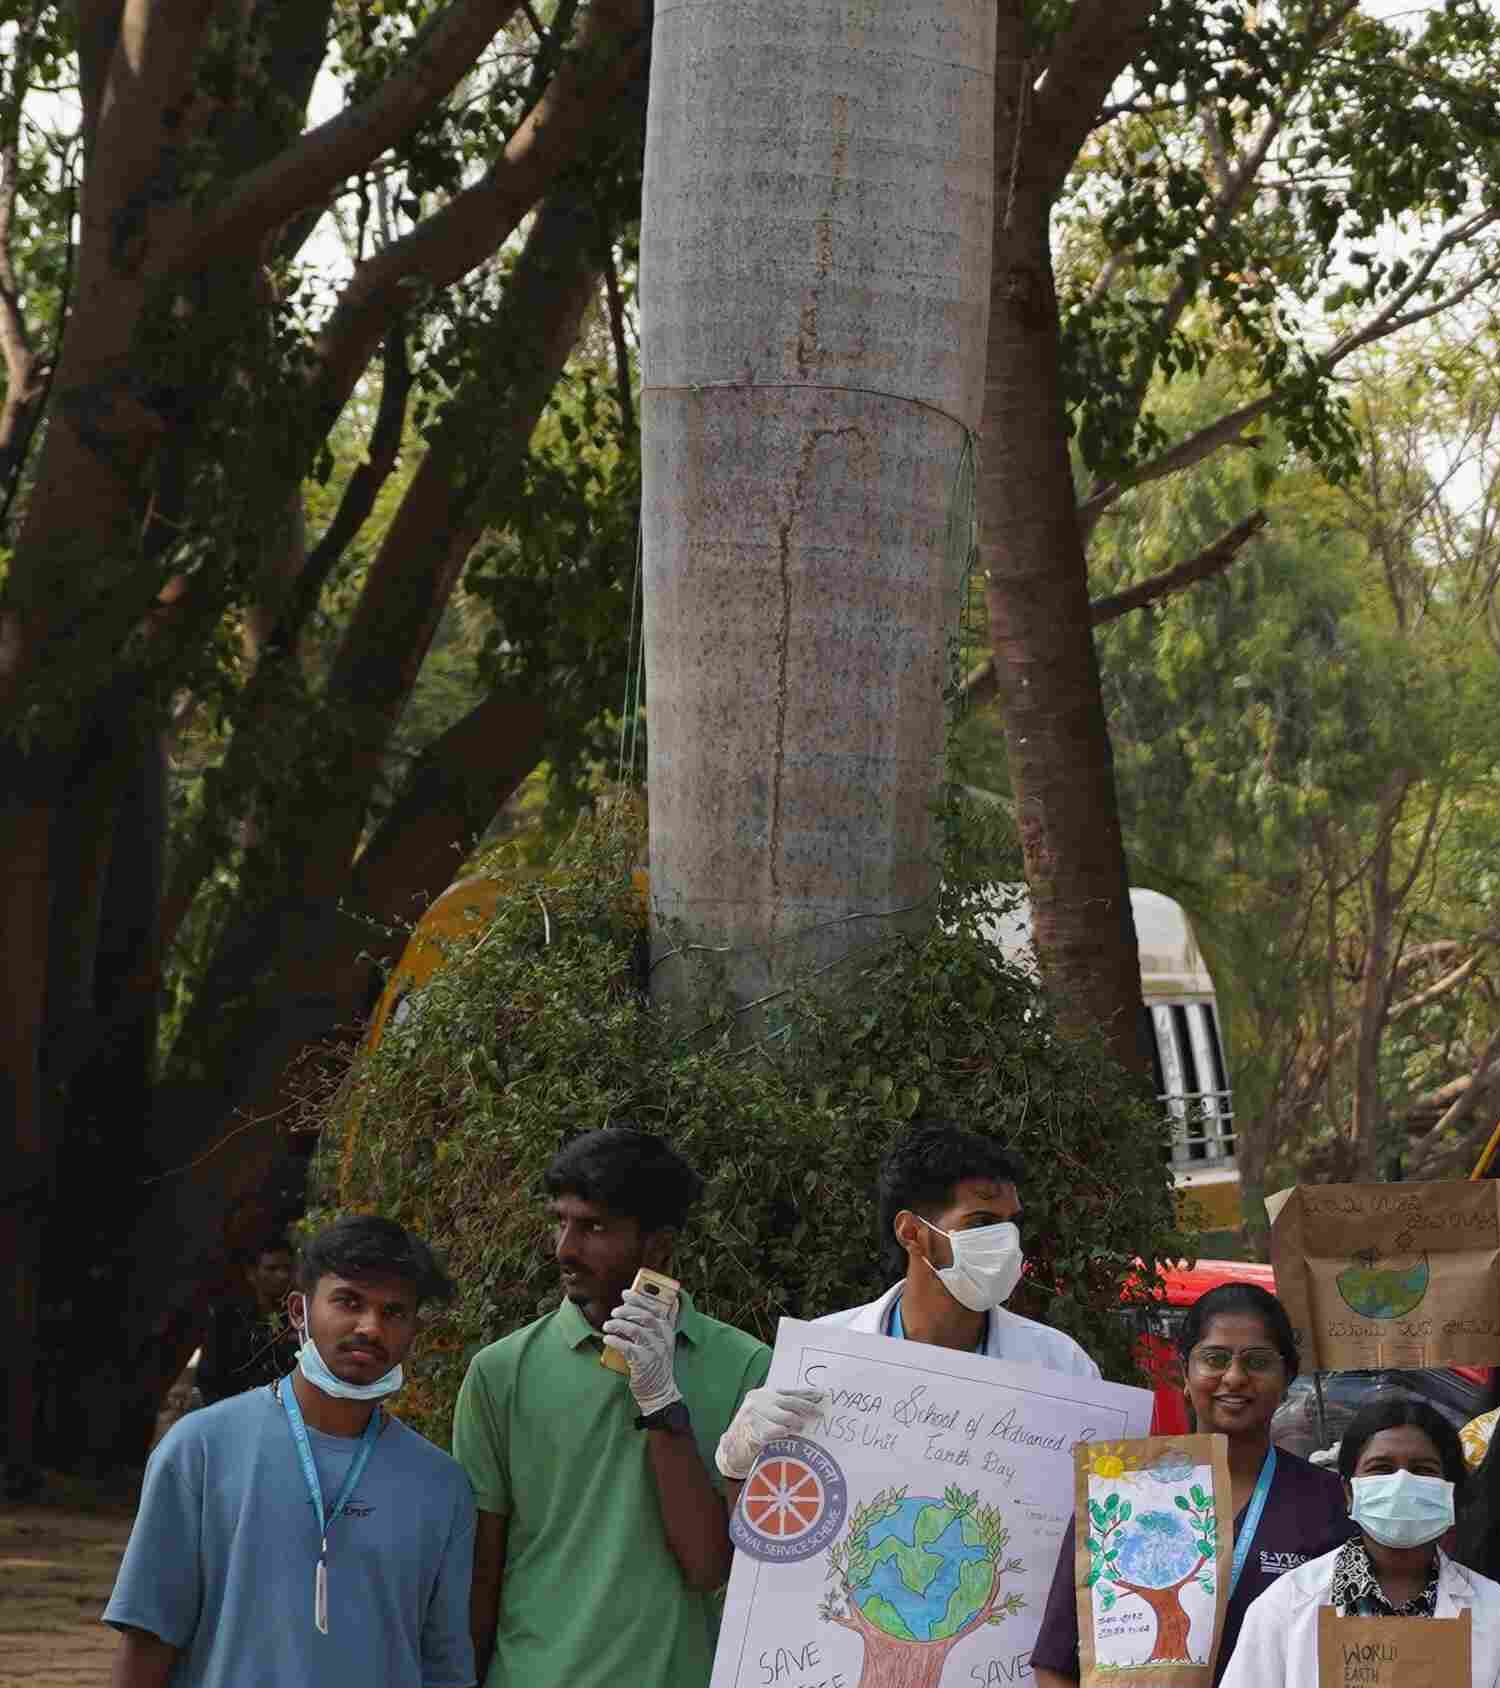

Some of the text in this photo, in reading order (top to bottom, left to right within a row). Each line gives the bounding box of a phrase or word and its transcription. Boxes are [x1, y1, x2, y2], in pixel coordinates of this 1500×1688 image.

[814, 1414, 899, 1452] NSS Unit
[894, 1384, 957, 1430] School
[964, 1410, 987, 1440] of
[991, 1408, 1068, 1452] Advanced
[922, 1432, 1017, 1486] Earth Day
[766, 1541, 810, 1556] SERVICE
[1260, 1551, 1312, 1567] S-VYAS
[759, 1641, 821, 1684] SAVE
